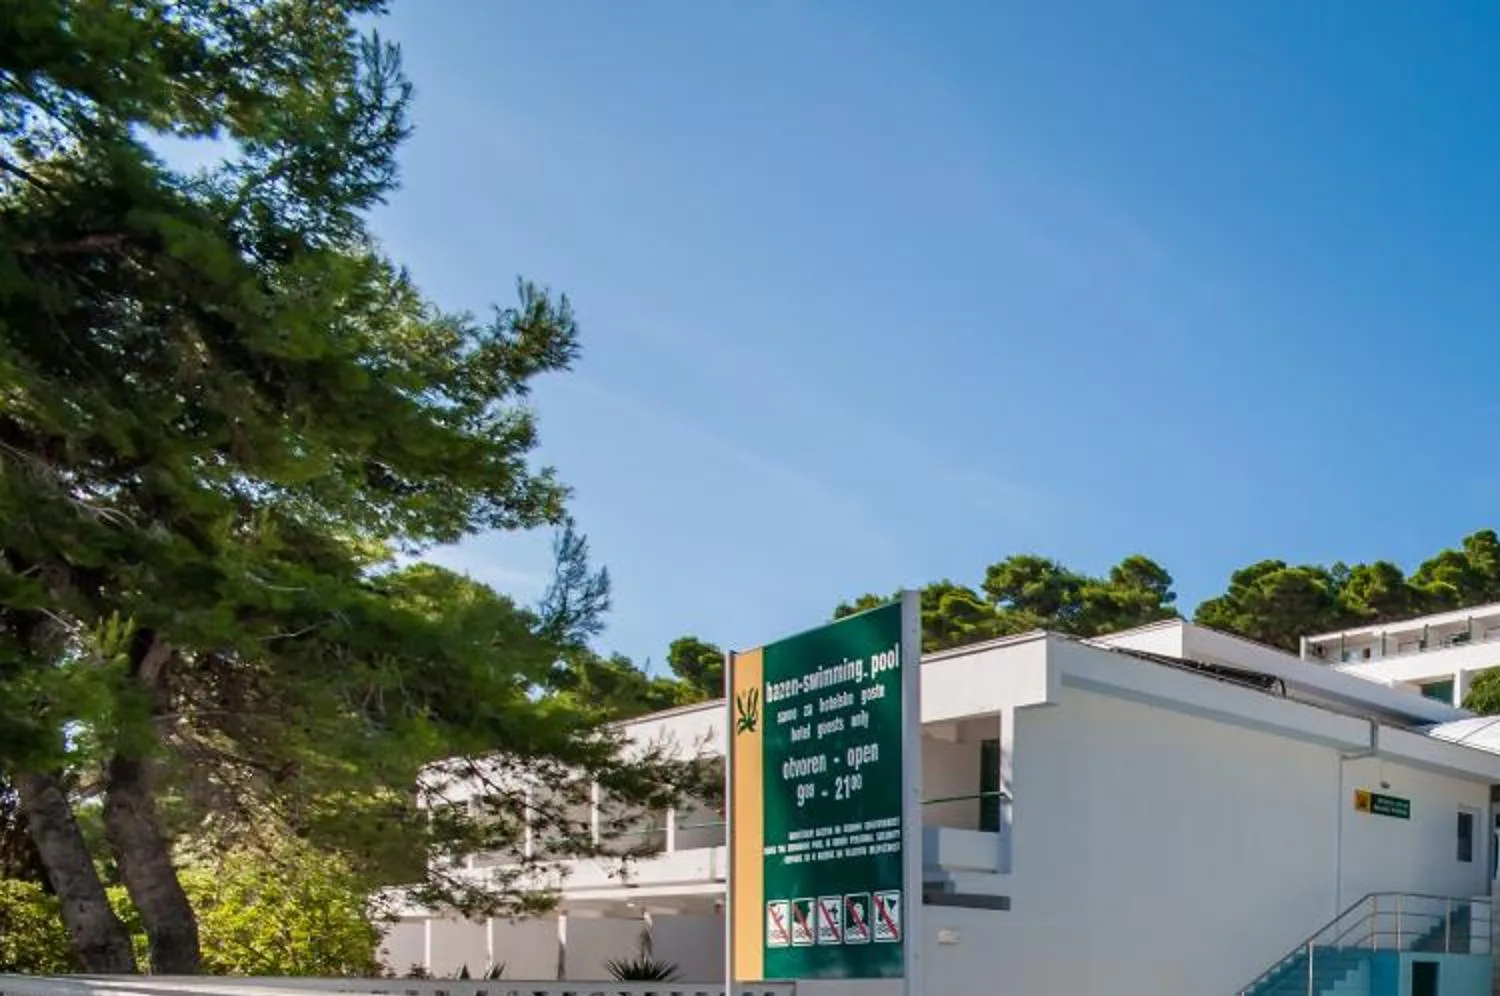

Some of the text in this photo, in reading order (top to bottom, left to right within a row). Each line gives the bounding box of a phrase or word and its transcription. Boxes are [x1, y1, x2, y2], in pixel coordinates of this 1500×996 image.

[871, 642, 899, 679] pool
[791, 722, 811, 742] hotel
[851, 709, 869, 728] only
[783, 754, 827, 780] otvoren
[847, 743, 879, 770] open
